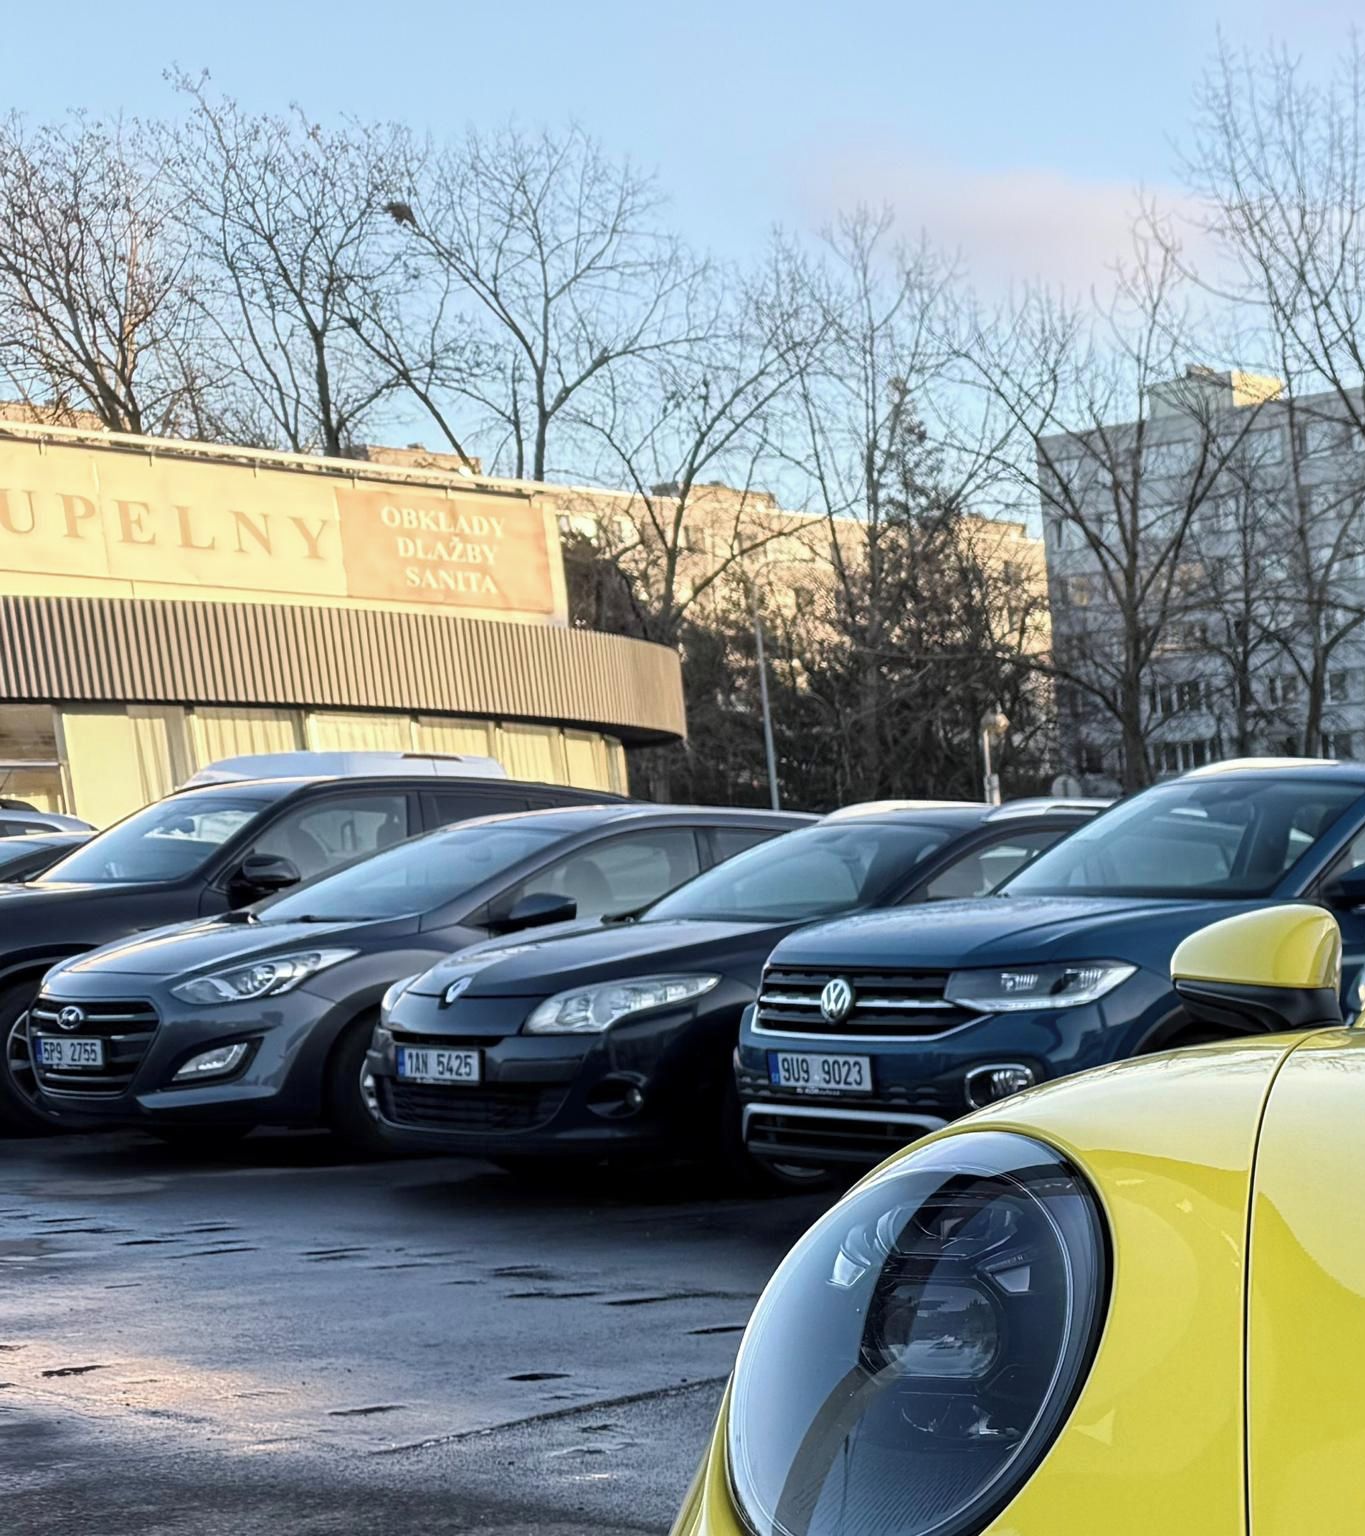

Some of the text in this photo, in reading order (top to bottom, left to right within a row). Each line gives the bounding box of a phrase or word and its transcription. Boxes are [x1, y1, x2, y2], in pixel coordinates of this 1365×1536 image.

[380, 505, 505, 539] OBKLADY
[396, 535, 497, 566] DLAŽBY
[405, 566, 498, 595] SANITA
[43, 1041, 97, 1062] 5P9 2755
[408, 1052, 472, 1077] 1AN 5425
[781, 1056, 864, 1086] 9U9 9023
